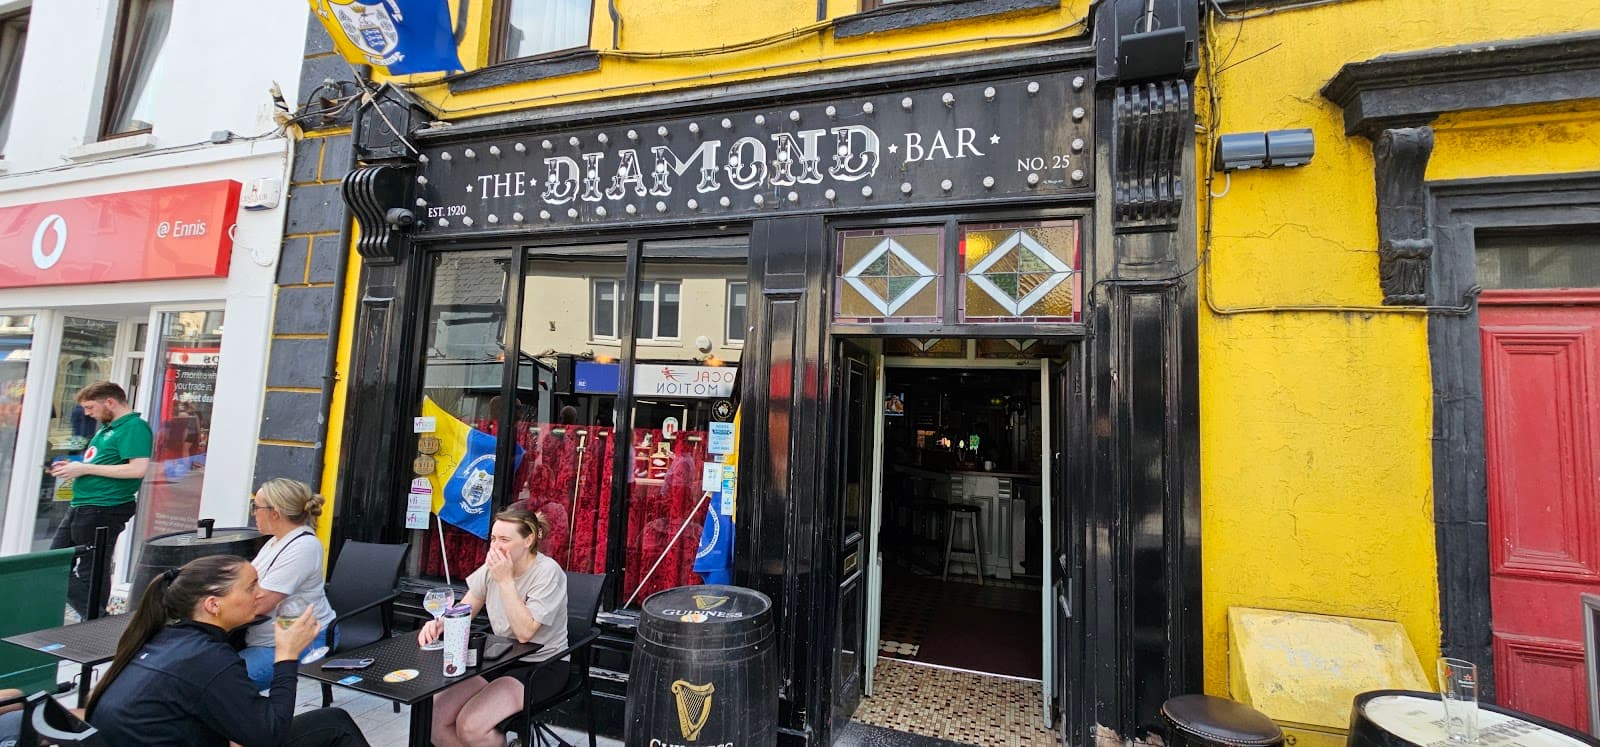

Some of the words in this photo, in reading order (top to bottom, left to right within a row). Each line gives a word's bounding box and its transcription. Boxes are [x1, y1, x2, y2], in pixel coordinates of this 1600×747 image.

[477, 171, 526, 199] THE
[541, 124, 881, 205] DIAMOND
[903, 127, 985, 163] BAR
[1017, 157, 1048, 172] NO.
[1052, 154, 1070, 169] 25
[428, 207, 446, 218] EST.
[447, 204, 468, 217] 1920
[156, 221, 170, 238] @
[172, 219, 207, 238] Ennis
[661, 608, 743, 618] GUINNESS
